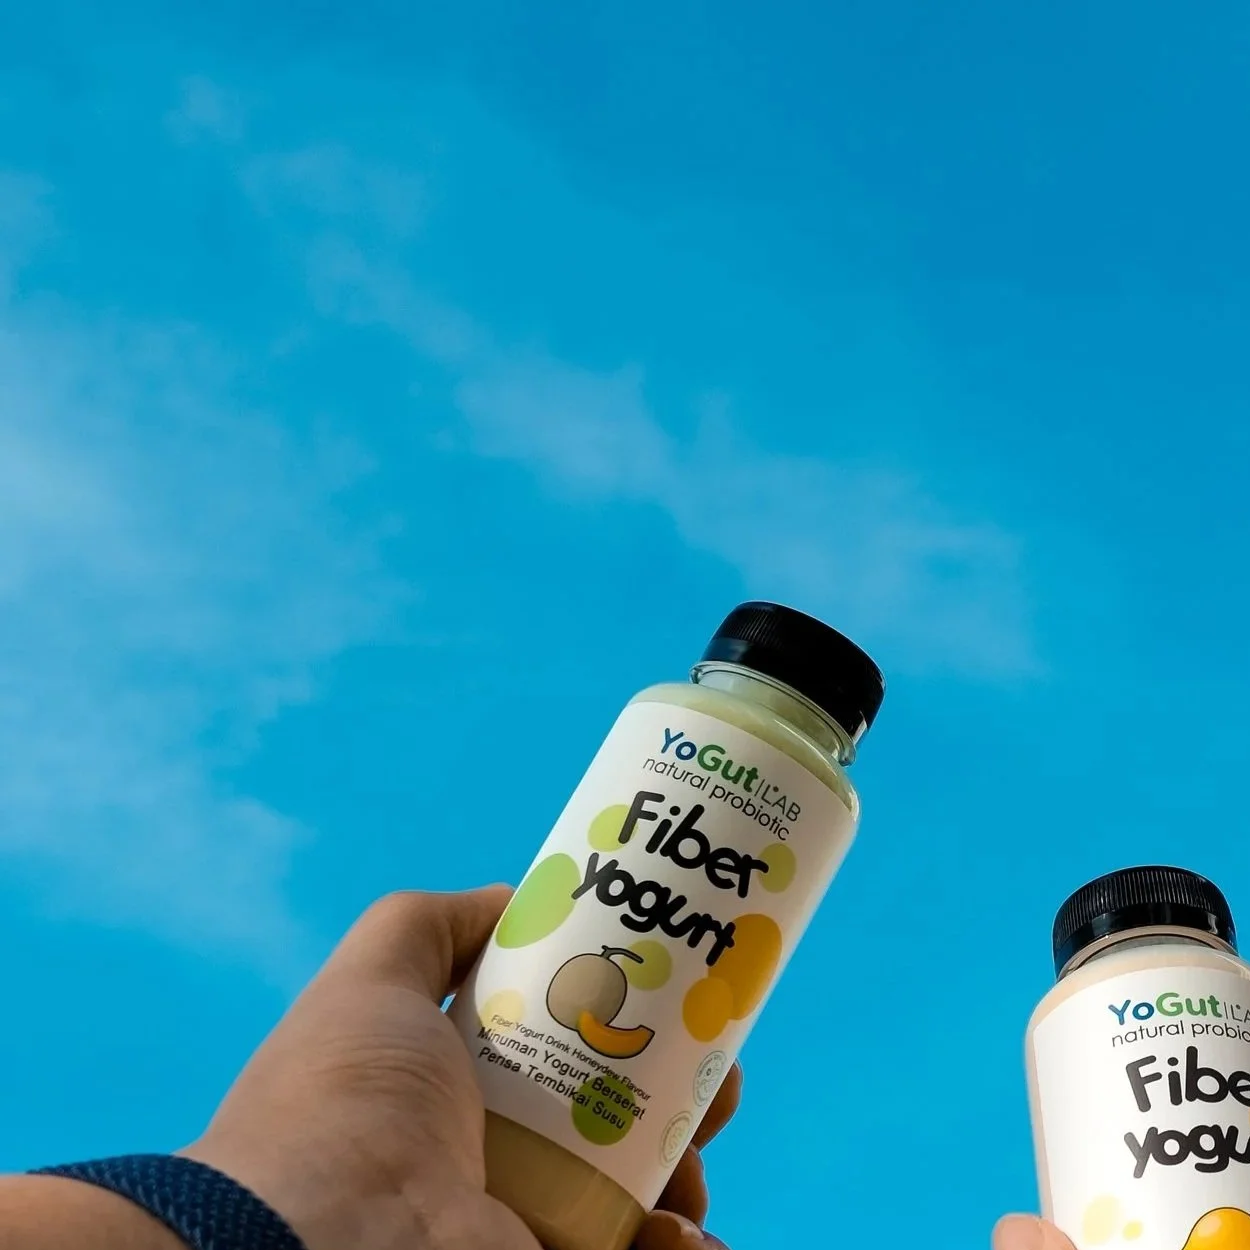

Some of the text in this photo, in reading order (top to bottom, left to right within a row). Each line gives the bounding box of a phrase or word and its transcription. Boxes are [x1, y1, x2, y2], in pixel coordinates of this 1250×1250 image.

[643, 758, 790, 841] natural probiotic
[618, 790, 769, 898] Fiber
[571, 852, 736, 966] yogurt
[477, 1027, 647, 1120] Minuman Yogurt Berserat
[515, 1021, 545, 1042] Yogurt
[545, 1035, 572, 1053] Drink
[571, 1048, 621, 1082] Honeydew
[620, 1076, 652, 1101] Flavour
[1111, 1020, 1185, 1047] natural
[478, 1047, 626, 1129] Perisa Tembikai Susu
